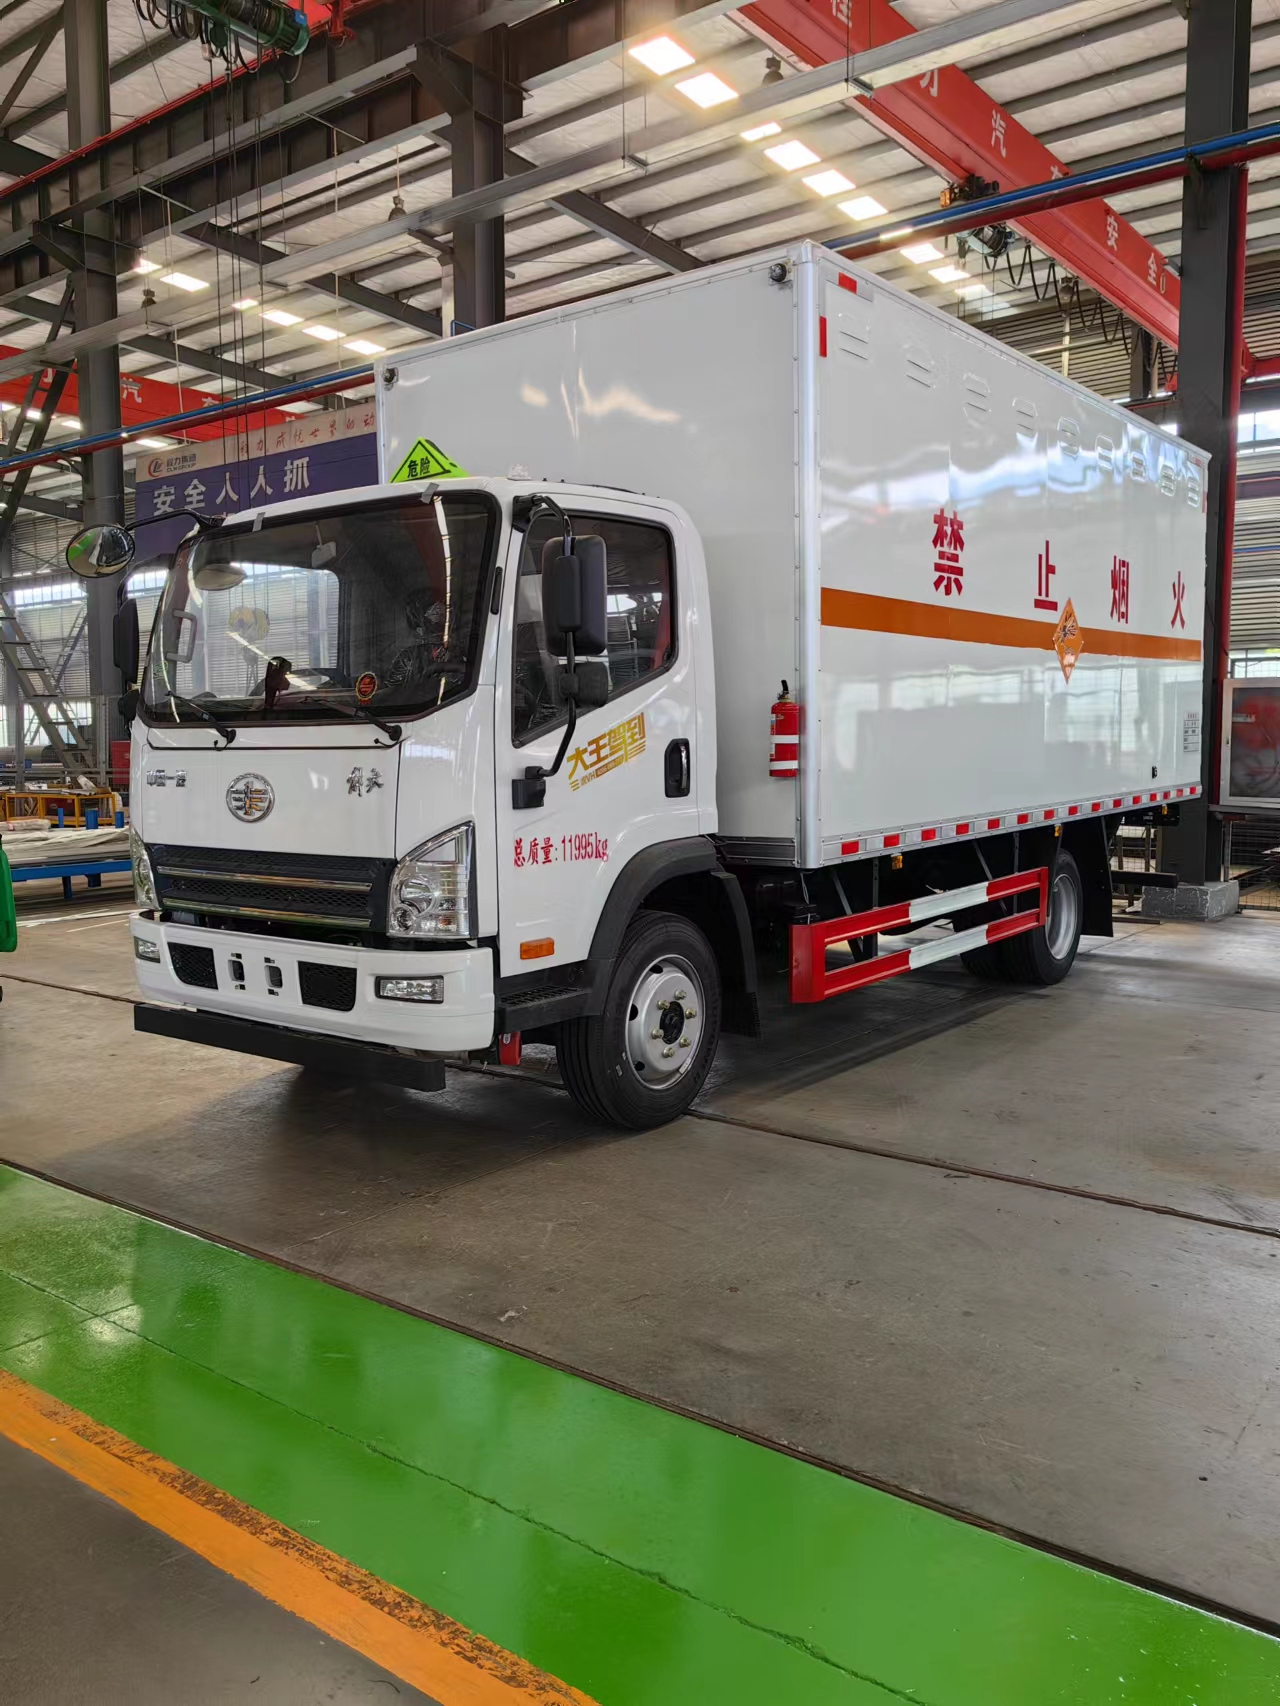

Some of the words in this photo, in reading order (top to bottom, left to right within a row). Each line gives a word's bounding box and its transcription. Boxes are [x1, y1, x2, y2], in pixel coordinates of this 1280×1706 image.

[153, 456, 311, 516] 安全人人抓
[408, 456, 430, 478] 危险
